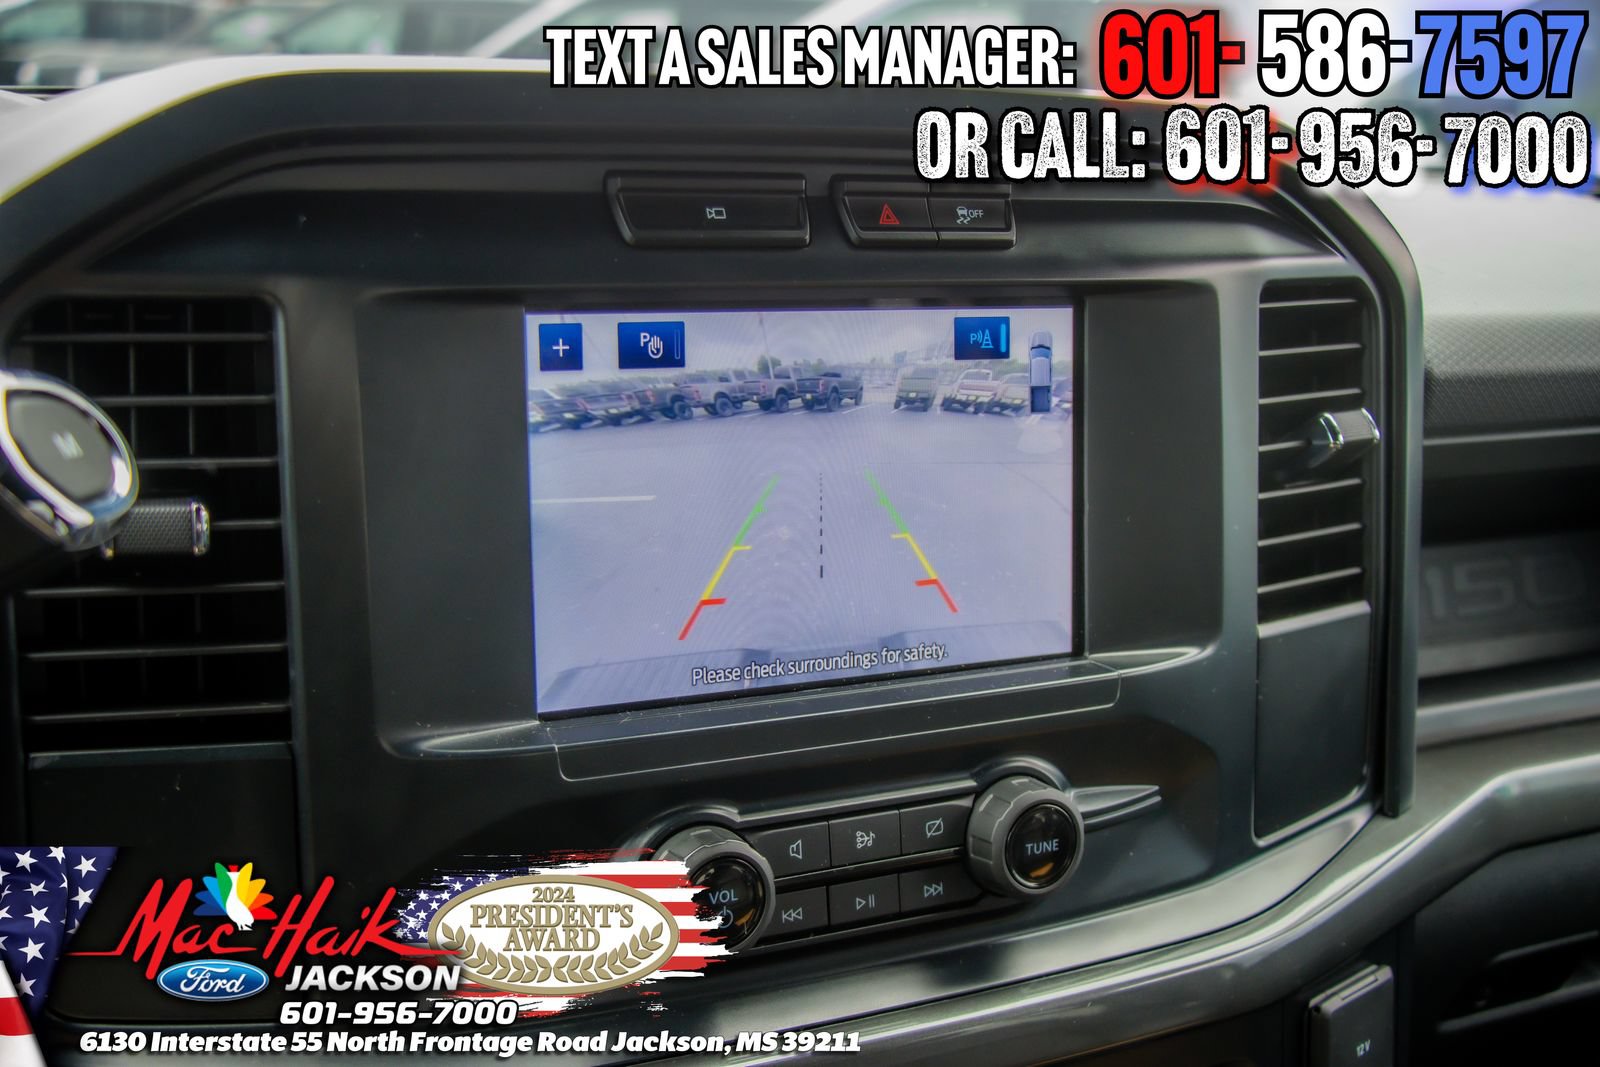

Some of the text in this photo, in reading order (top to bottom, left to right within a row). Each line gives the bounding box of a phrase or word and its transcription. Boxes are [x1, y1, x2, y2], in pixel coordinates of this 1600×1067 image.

[968, 209, 984, 218] OFF
[691, 643, 948, 686] Please check surroundings for safety.
[1025, 839, 1059, 856] TUNE
[709, 889, 738, 904] VOL
